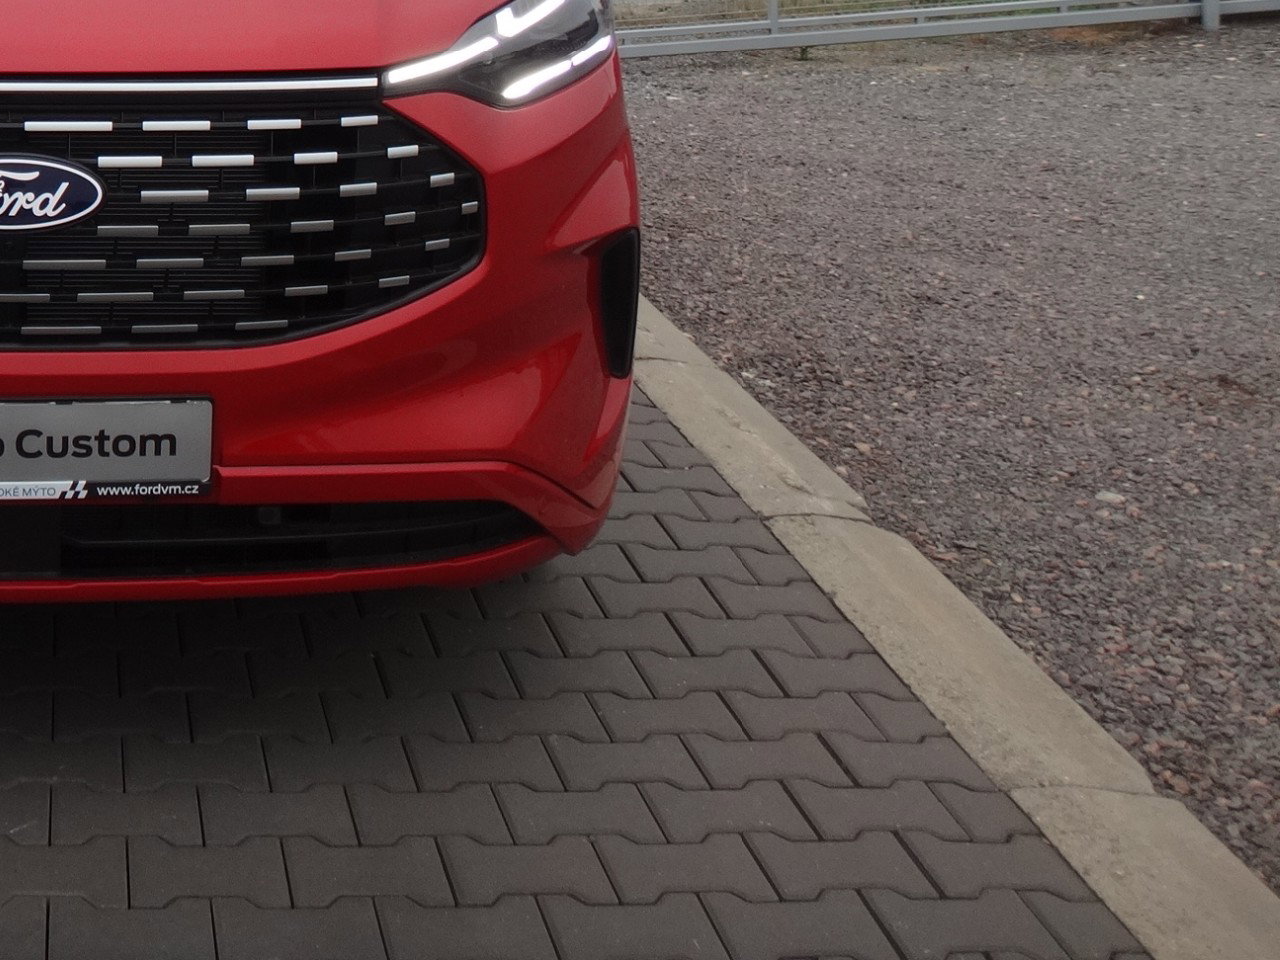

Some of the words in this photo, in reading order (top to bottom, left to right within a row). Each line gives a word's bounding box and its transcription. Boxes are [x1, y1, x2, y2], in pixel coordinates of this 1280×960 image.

[15, 429, 178, 458] Custom
[22, 486, 56, 497] MÝTO
[96, 483, 200, 496] www.fordvm.cz
